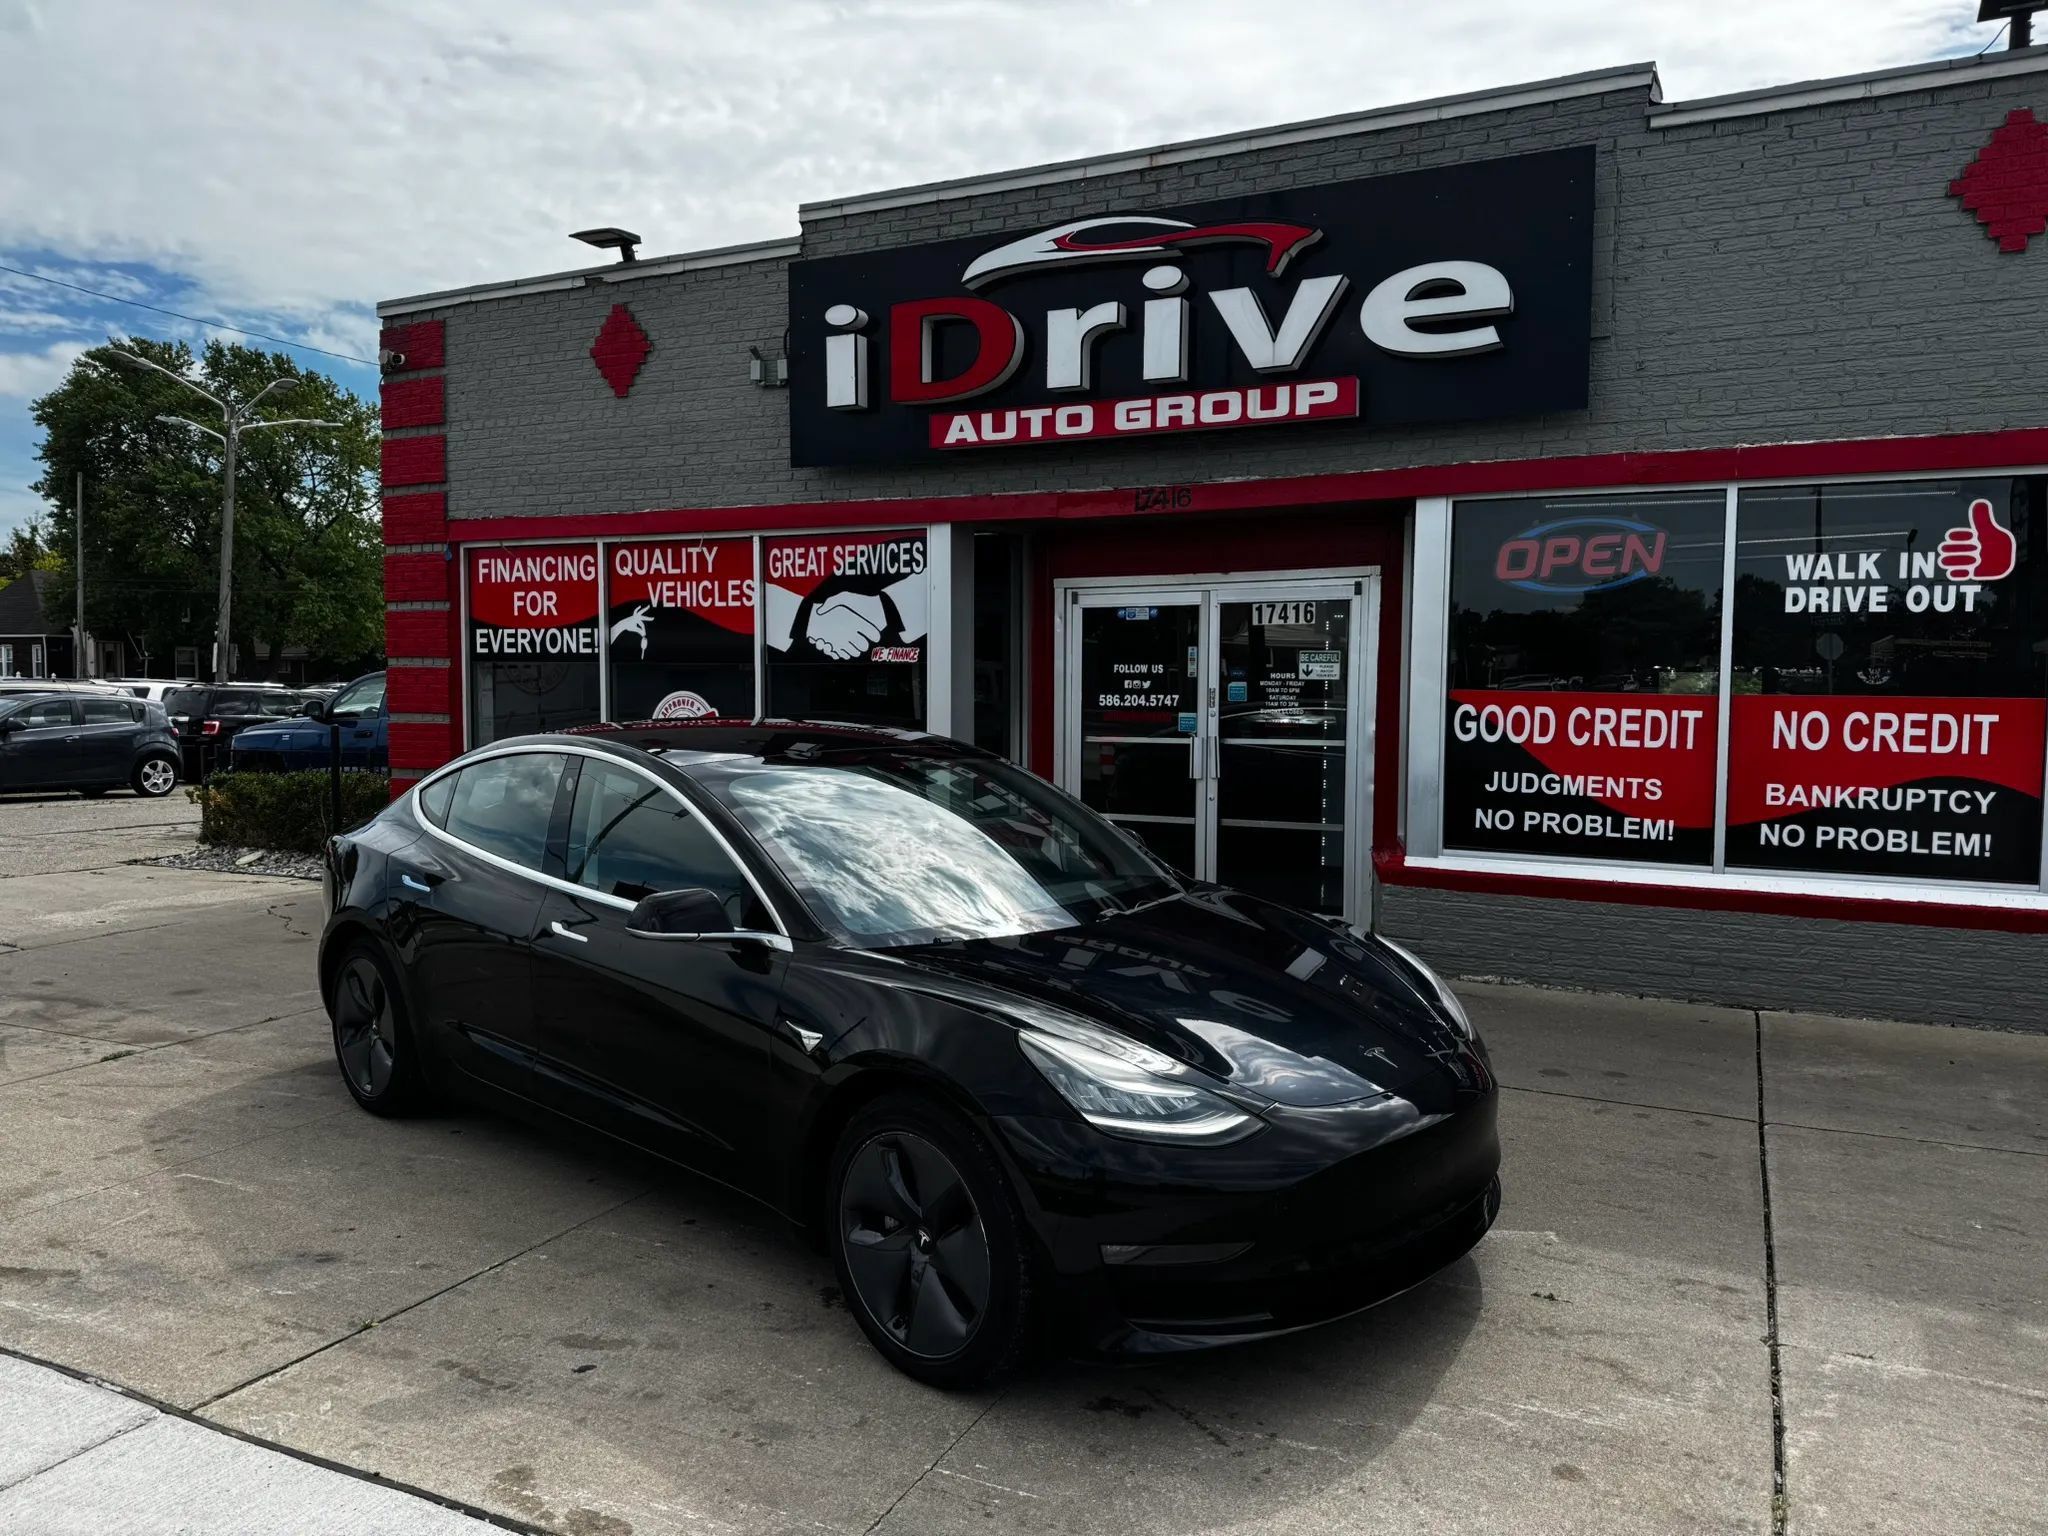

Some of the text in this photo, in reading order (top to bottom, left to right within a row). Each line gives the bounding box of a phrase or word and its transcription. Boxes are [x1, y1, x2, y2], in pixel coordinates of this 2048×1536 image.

[825, 260, 1514, 410] iDrive
[943, 381, 1338, 445] AUTO GROUP
[478, 554, 596, 584] FINANCING
[615, 546, 718, 577] QUALITY
[769, 541, 924, 578] GREAT SERVICES
[1495, 532, 1667, 580] OPEN
[1785, 551, 1935, 581] WALK IN
[513, 590, 558, 617] FOR
[647, 579, 755, 609] VEHICLES
[1785, 584, 1981, 613] DRIVE OUT
[1255, 602, 1314, 624] 17416
[475, 627, 599, 654] EVERYONE!
[871, 647, 920, 662] WE FINANCE
[1113, 664, 1164, 674] FOLLOW US
[1310, 653, 1339, 662] CAREFUL
[661, 698, 695, 718] APPROVED
[1099, 694, 1179, 707] 586.204.5747
[1453, 703, 1702, 750] GOOD CREDIT
[1772, 711, 1999, 755] NO CREDIT
[1484, 771, 1663, 801] JUDGMENTS
[1765, 783, 1997, 815] BANKRUPTCY
[1474, 808, 1674, 842] NO PROBLEM!
[1759, 823, 1992, 858] NO PROBLEM!
